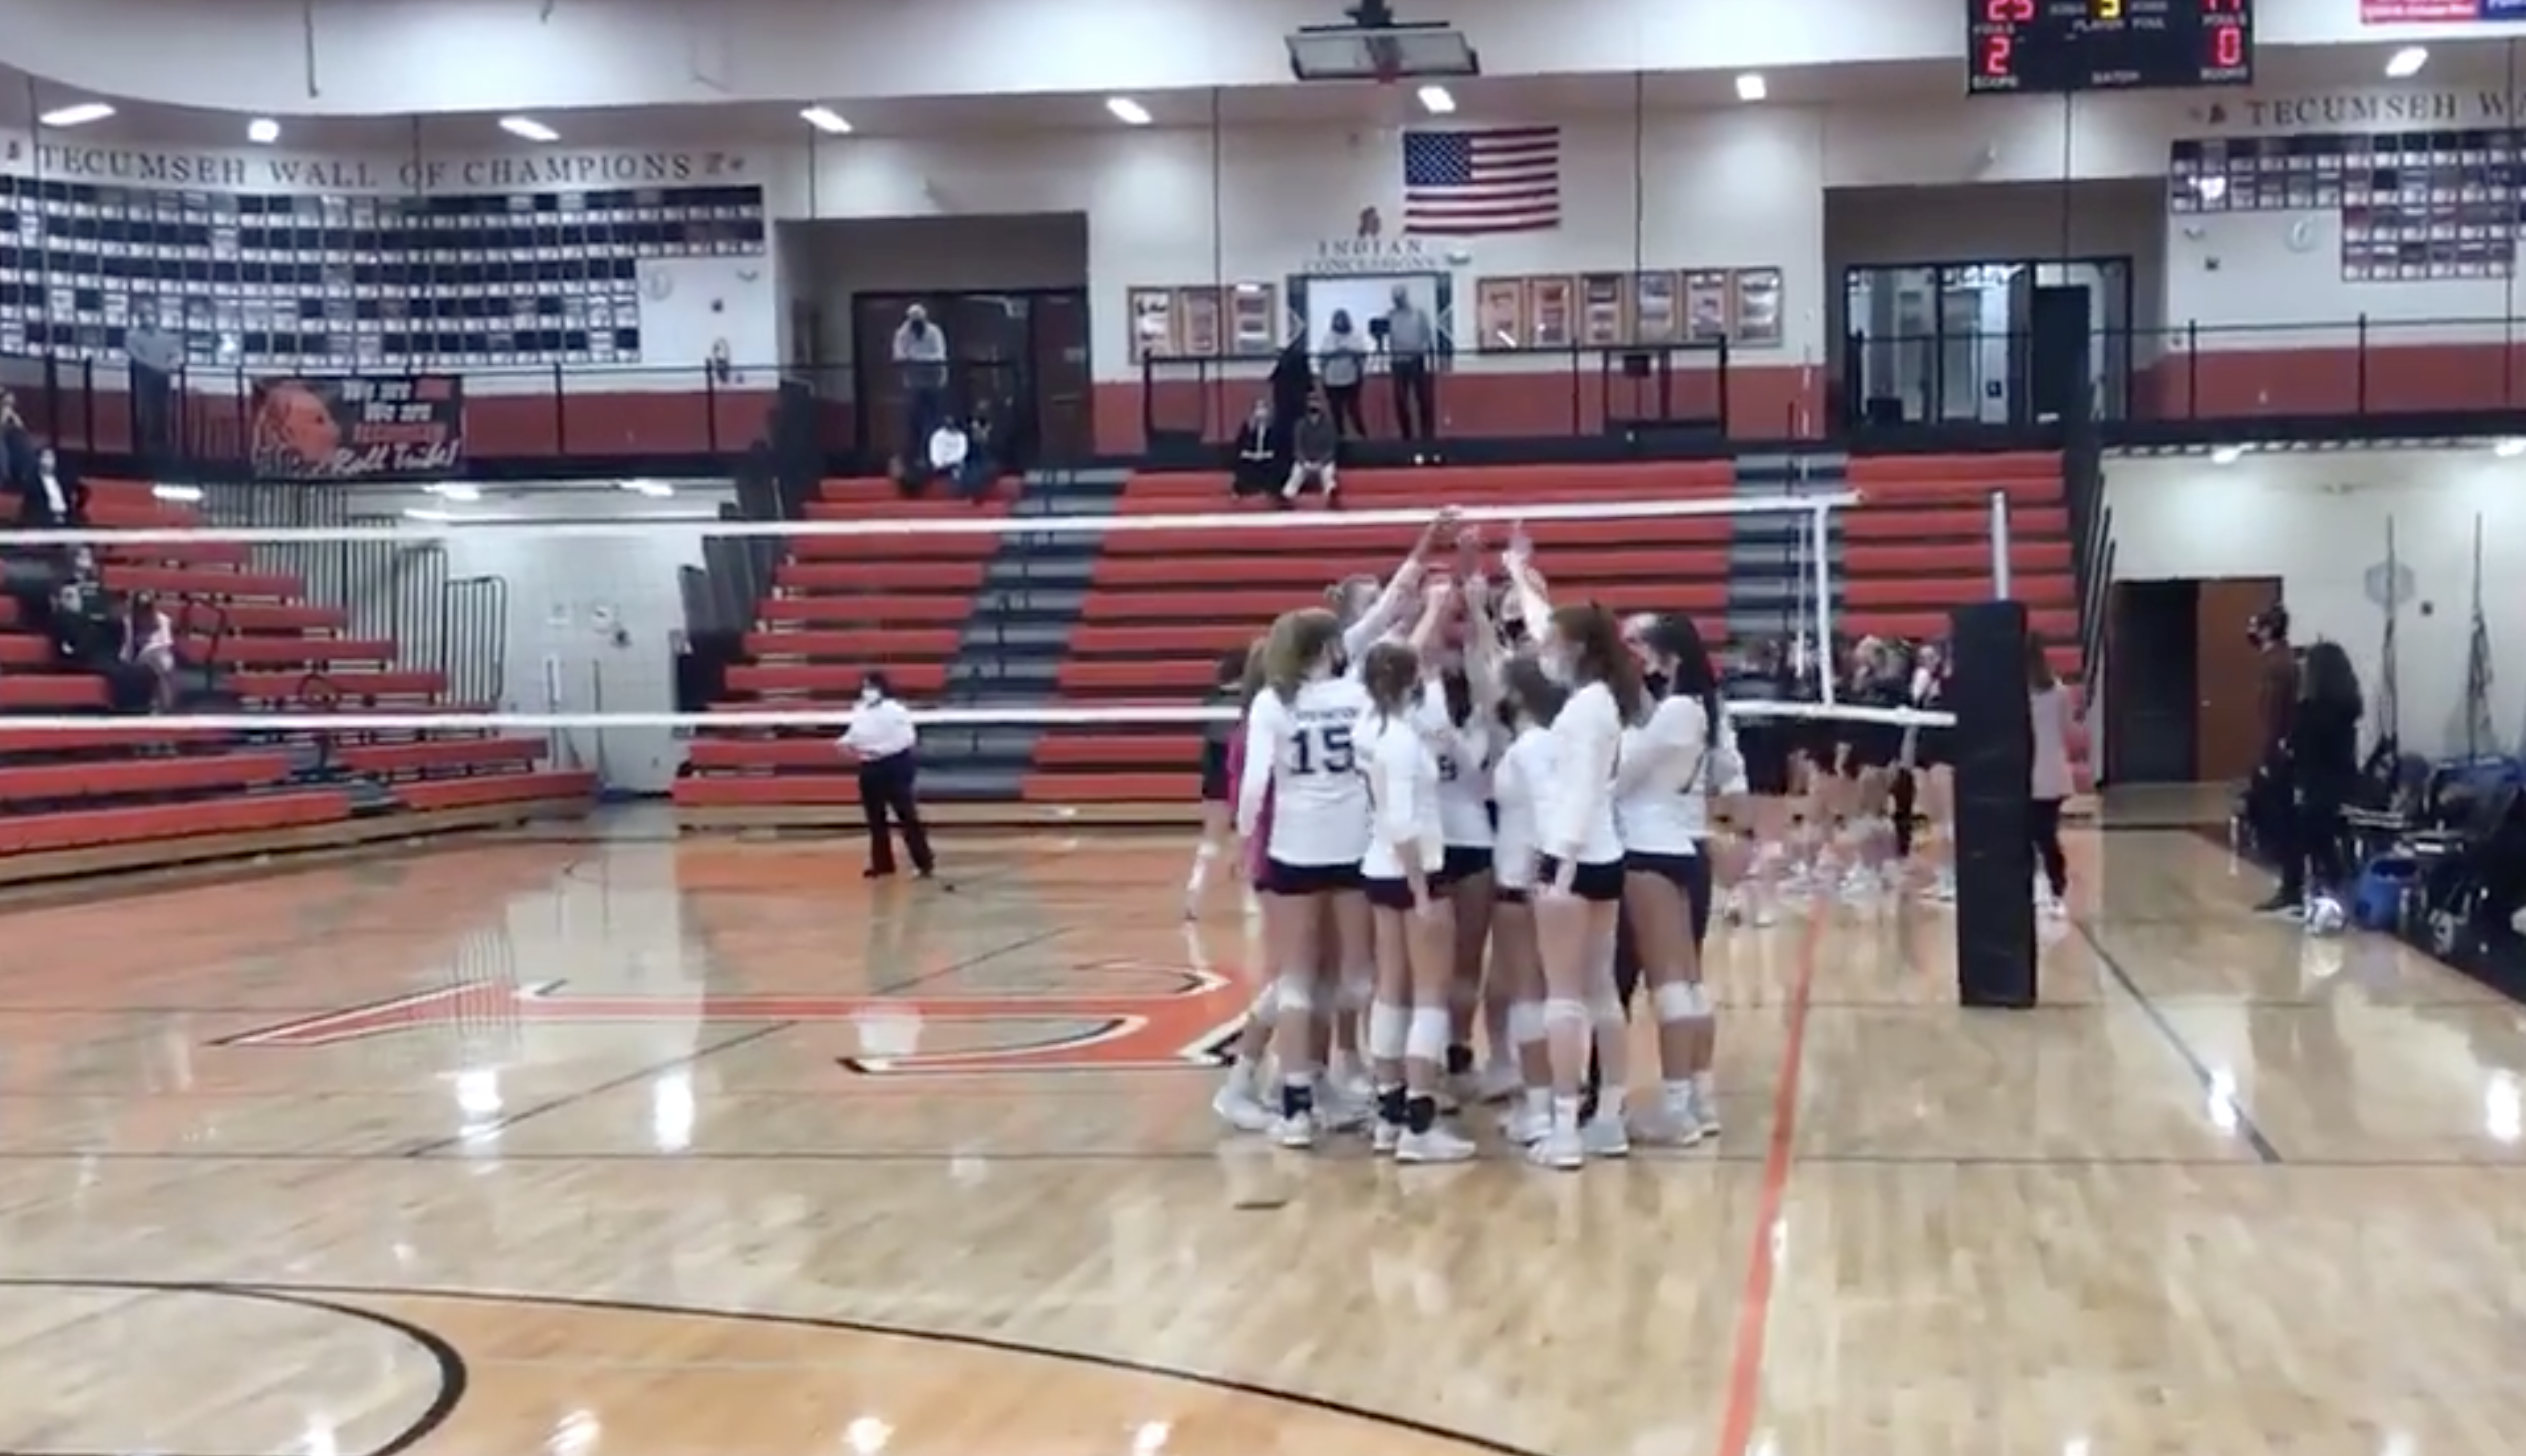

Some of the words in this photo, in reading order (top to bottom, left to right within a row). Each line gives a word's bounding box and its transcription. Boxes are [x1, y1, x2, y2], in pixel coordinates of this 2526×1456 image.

[1987, 35, 2011, 75] 2
[2217, 27, 2242, 66] 0
[2246, 92, 2456, 127] TECUMSEH
[36, 143, 247, 185] TECUMSEH
[268, 159, 379, 188] WALL
[399, 160, 447, 188] OF
[463, 153, 692, 186] CHAMPIONS
[1289, 726, 1355, 775] 15
